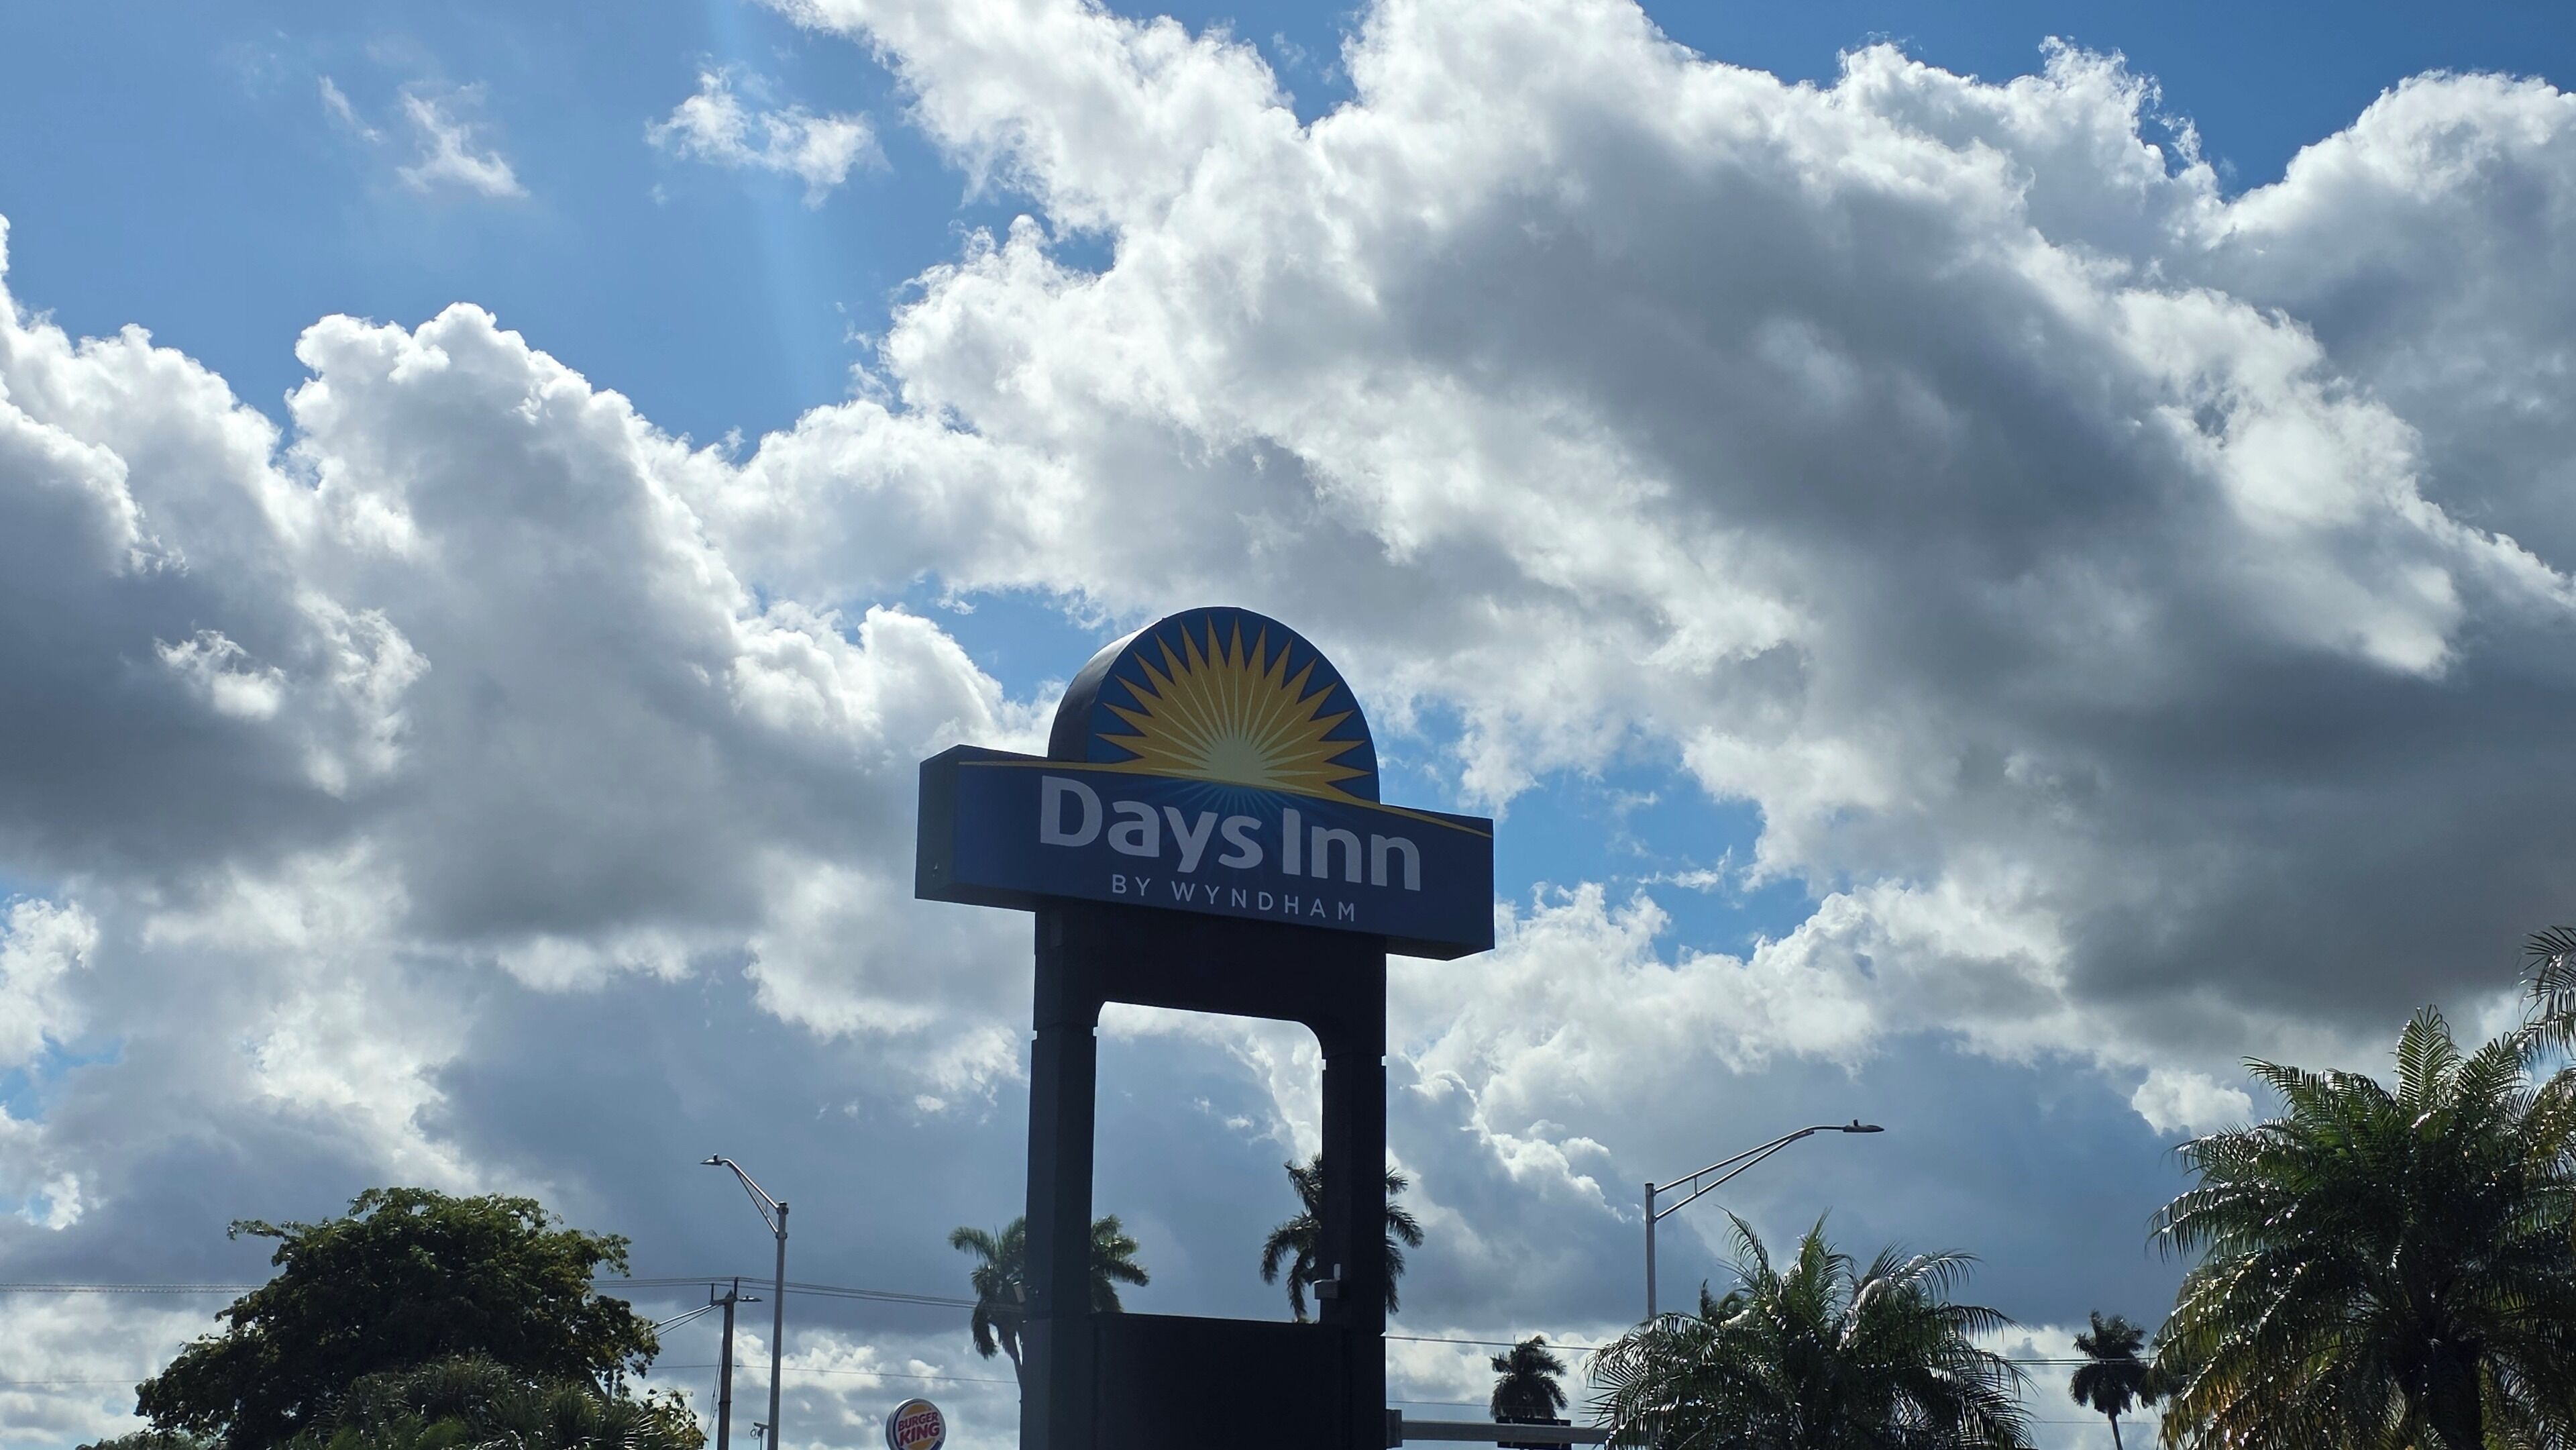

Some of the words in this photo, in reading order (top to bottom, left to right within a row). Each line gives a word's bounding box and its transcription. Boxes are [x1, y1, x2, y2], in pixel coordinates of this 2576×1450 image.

[1040, 776, 1263, 873] Days
[1283, 808, 1421, 891] Inn
[1112, 874, 1151, 896] BY
[1172, 881, 1355, 923] WYNDHAM
[898, 1412, 938, 1432] BURGER
[900, 1422, 940, 1446] KING
